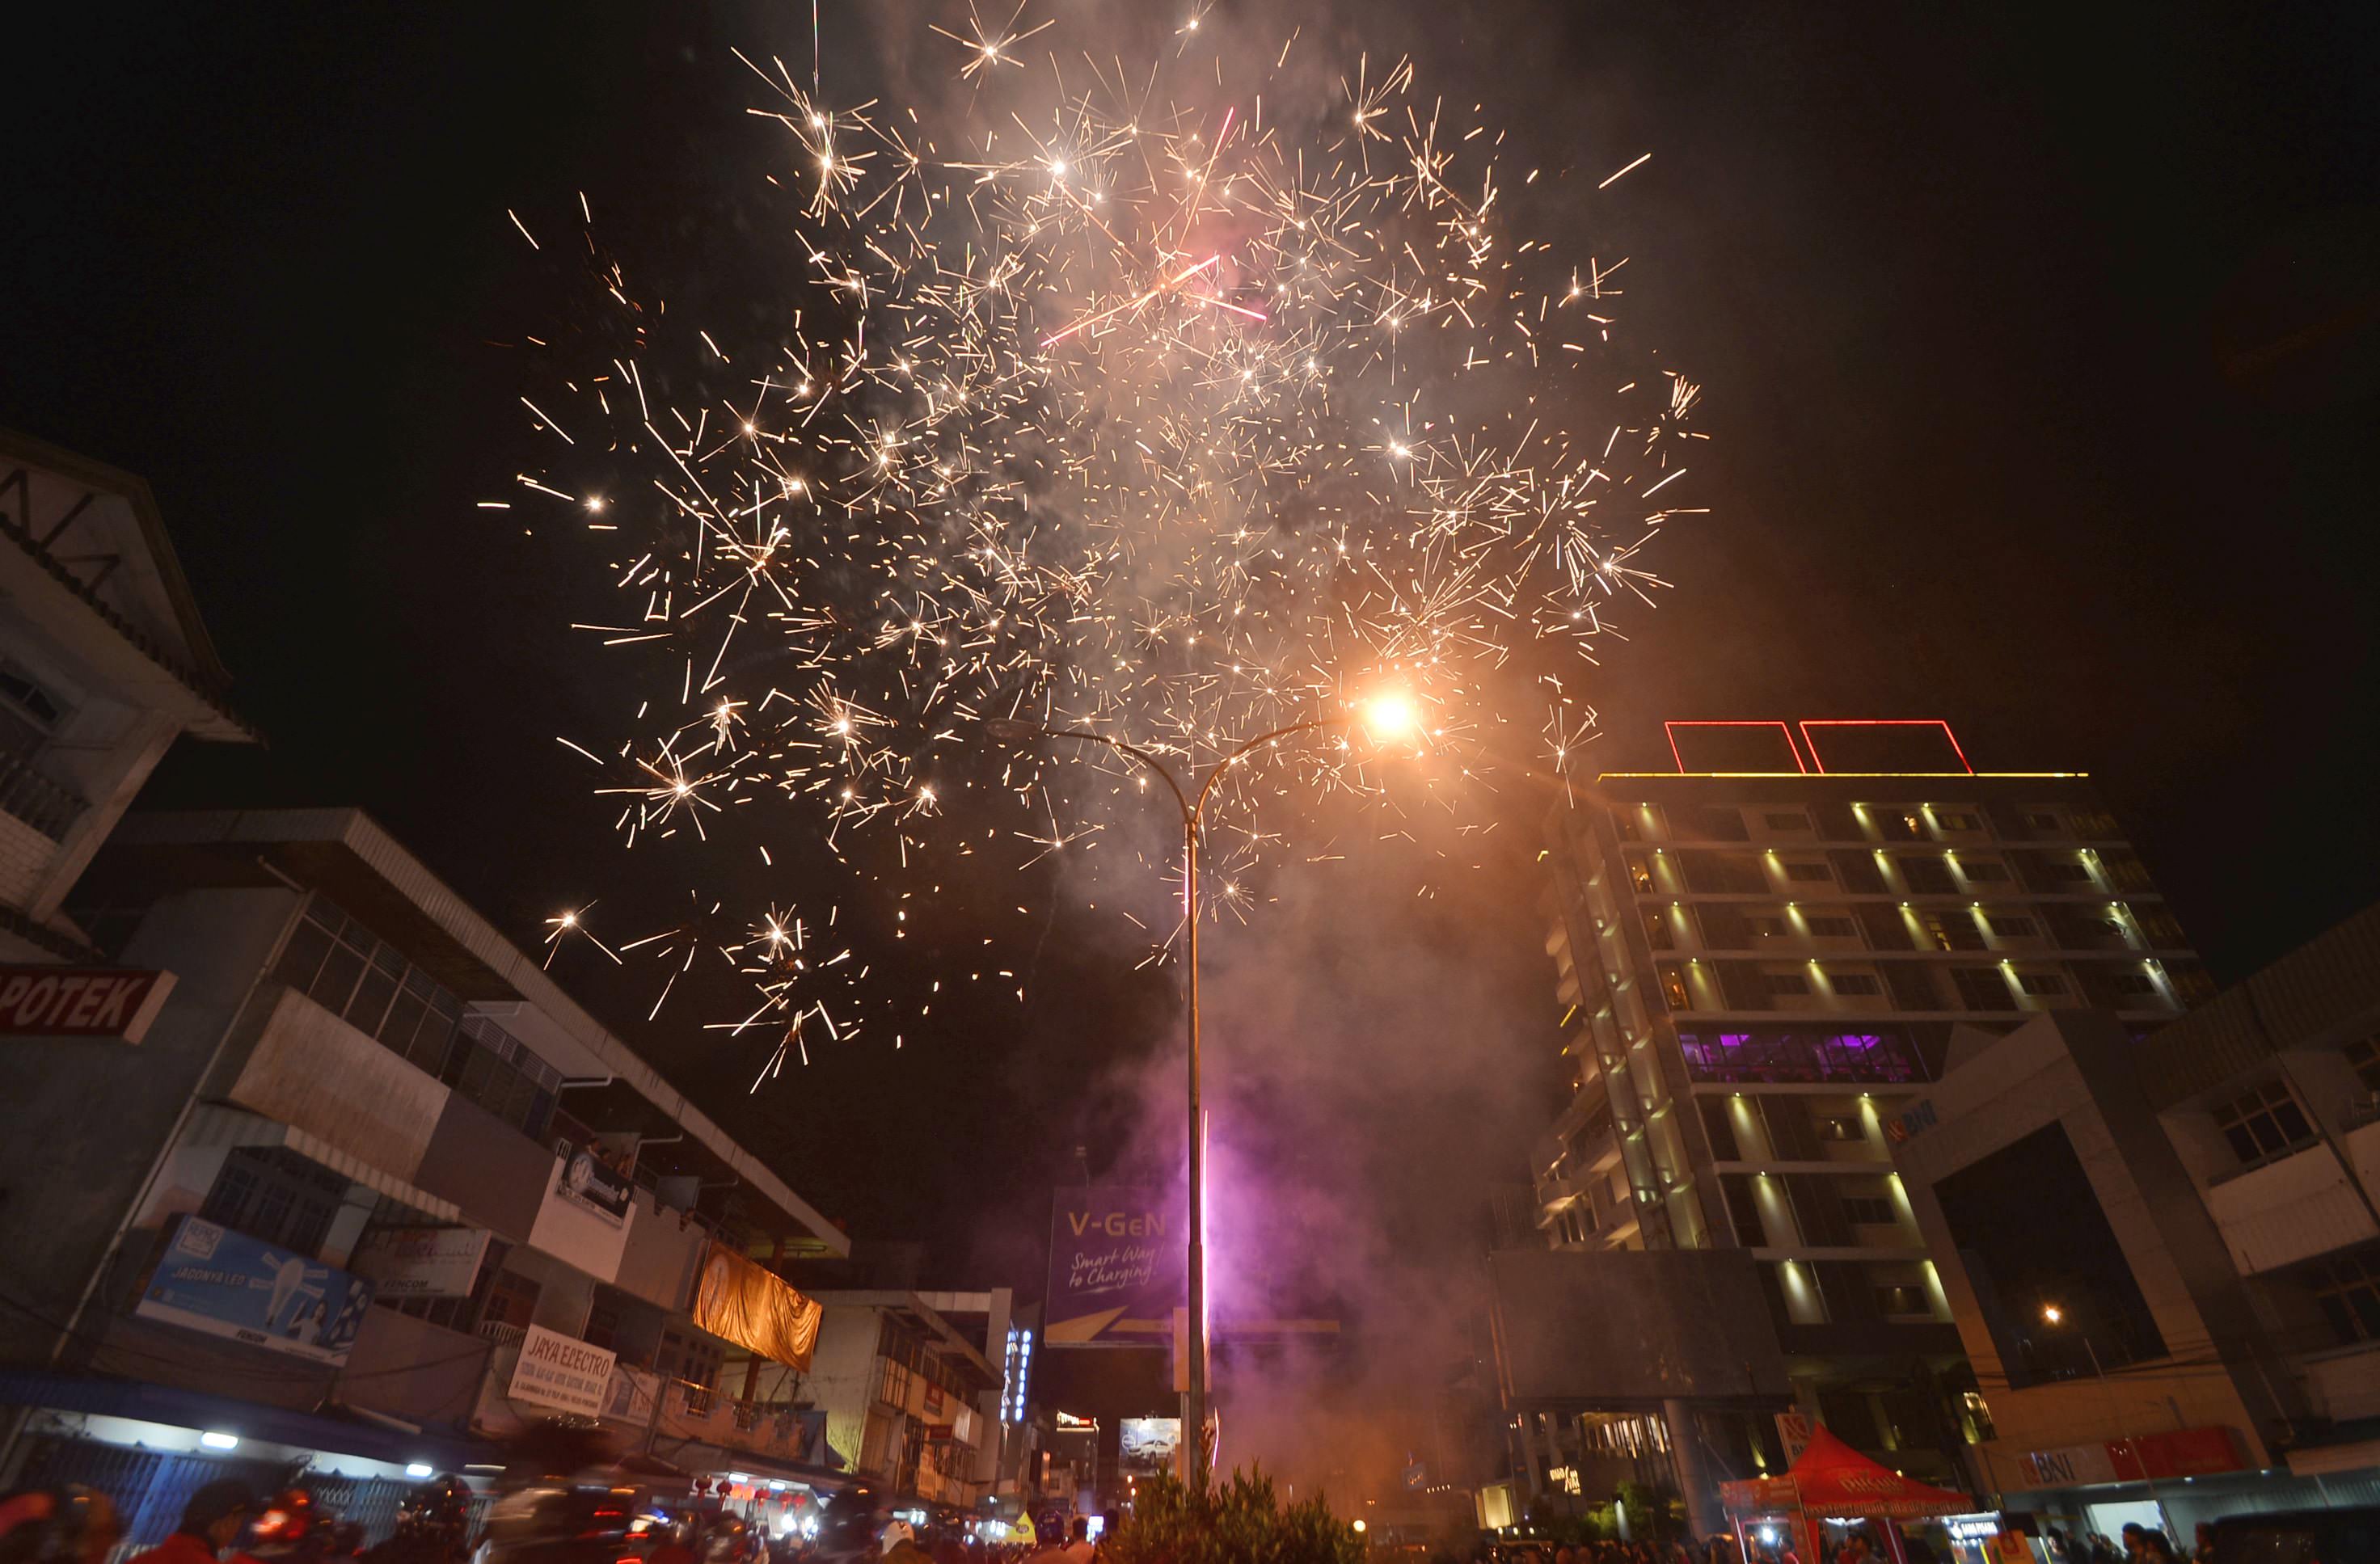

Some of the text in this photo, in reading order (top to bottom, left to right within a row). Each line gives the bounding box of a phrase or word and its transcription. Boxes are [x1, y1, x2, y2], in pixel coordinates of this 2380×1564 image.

[0, 976, 146, 1027] POTEK
[1071, 1247, 1118, 1271] Smart
[1069, 1272, 1082, 1288] to
[528, 1335, 559, 1363] JAYA
[2036, 1452, 2074, 1482] BNI
